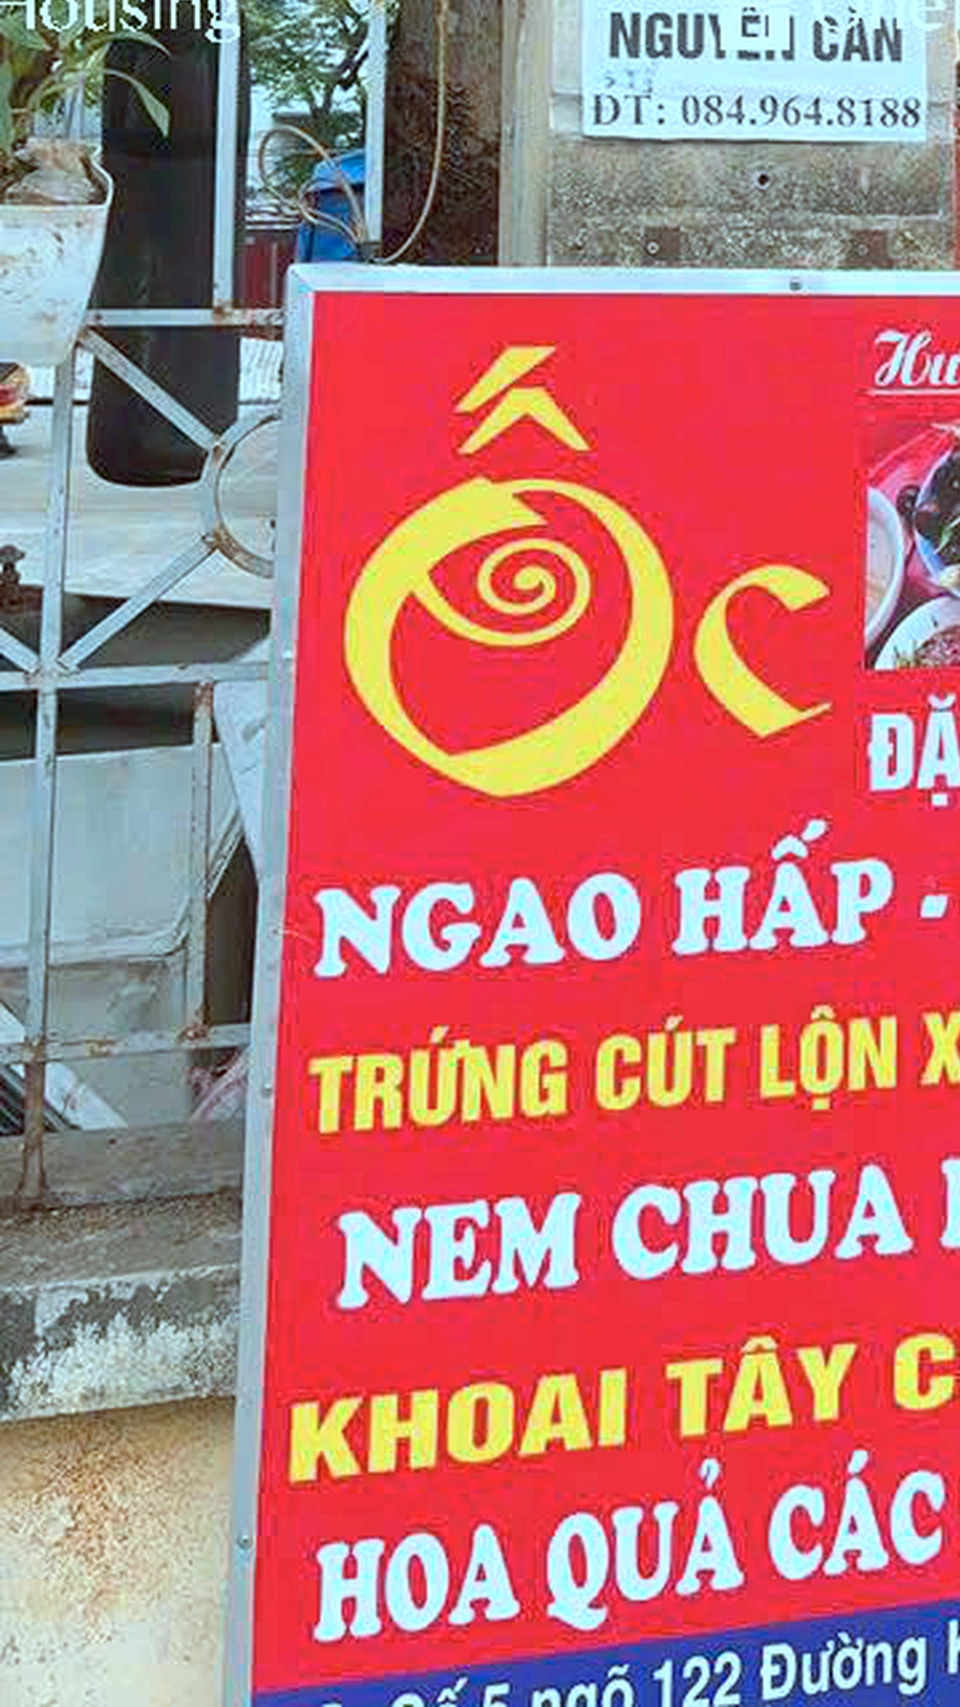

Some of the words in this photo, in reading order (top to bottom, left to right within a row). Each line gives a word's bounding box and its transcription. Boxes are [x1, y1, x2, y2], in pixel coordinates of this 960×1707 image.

[682, 94, 922, 127] 084.964.8188
[314, 872, 642, 978] NGAO
[671, 819, 894, 956] HẤP
[309, 1025, 568, 1134] TRỨNG
[595, 1015, 736, 1111] CÚT
[759, 1006, 898, 1111] LỘN
[337, 1192, 582, 1309] NEM
[611, 1164, 910, 1280] CHUA
[289, 1368, 627, 1482] KHOAI
[665, 1335, 857, 1447] TÂY
[314, 1524, 521, 1642] HOA
[546, 1457, 745, 1632] QUẢ
[768, 1449, 946, 1581] CÁC
[652, 1650, 742, 1707] 122
[759, 1632, 928, 1697] Đường
